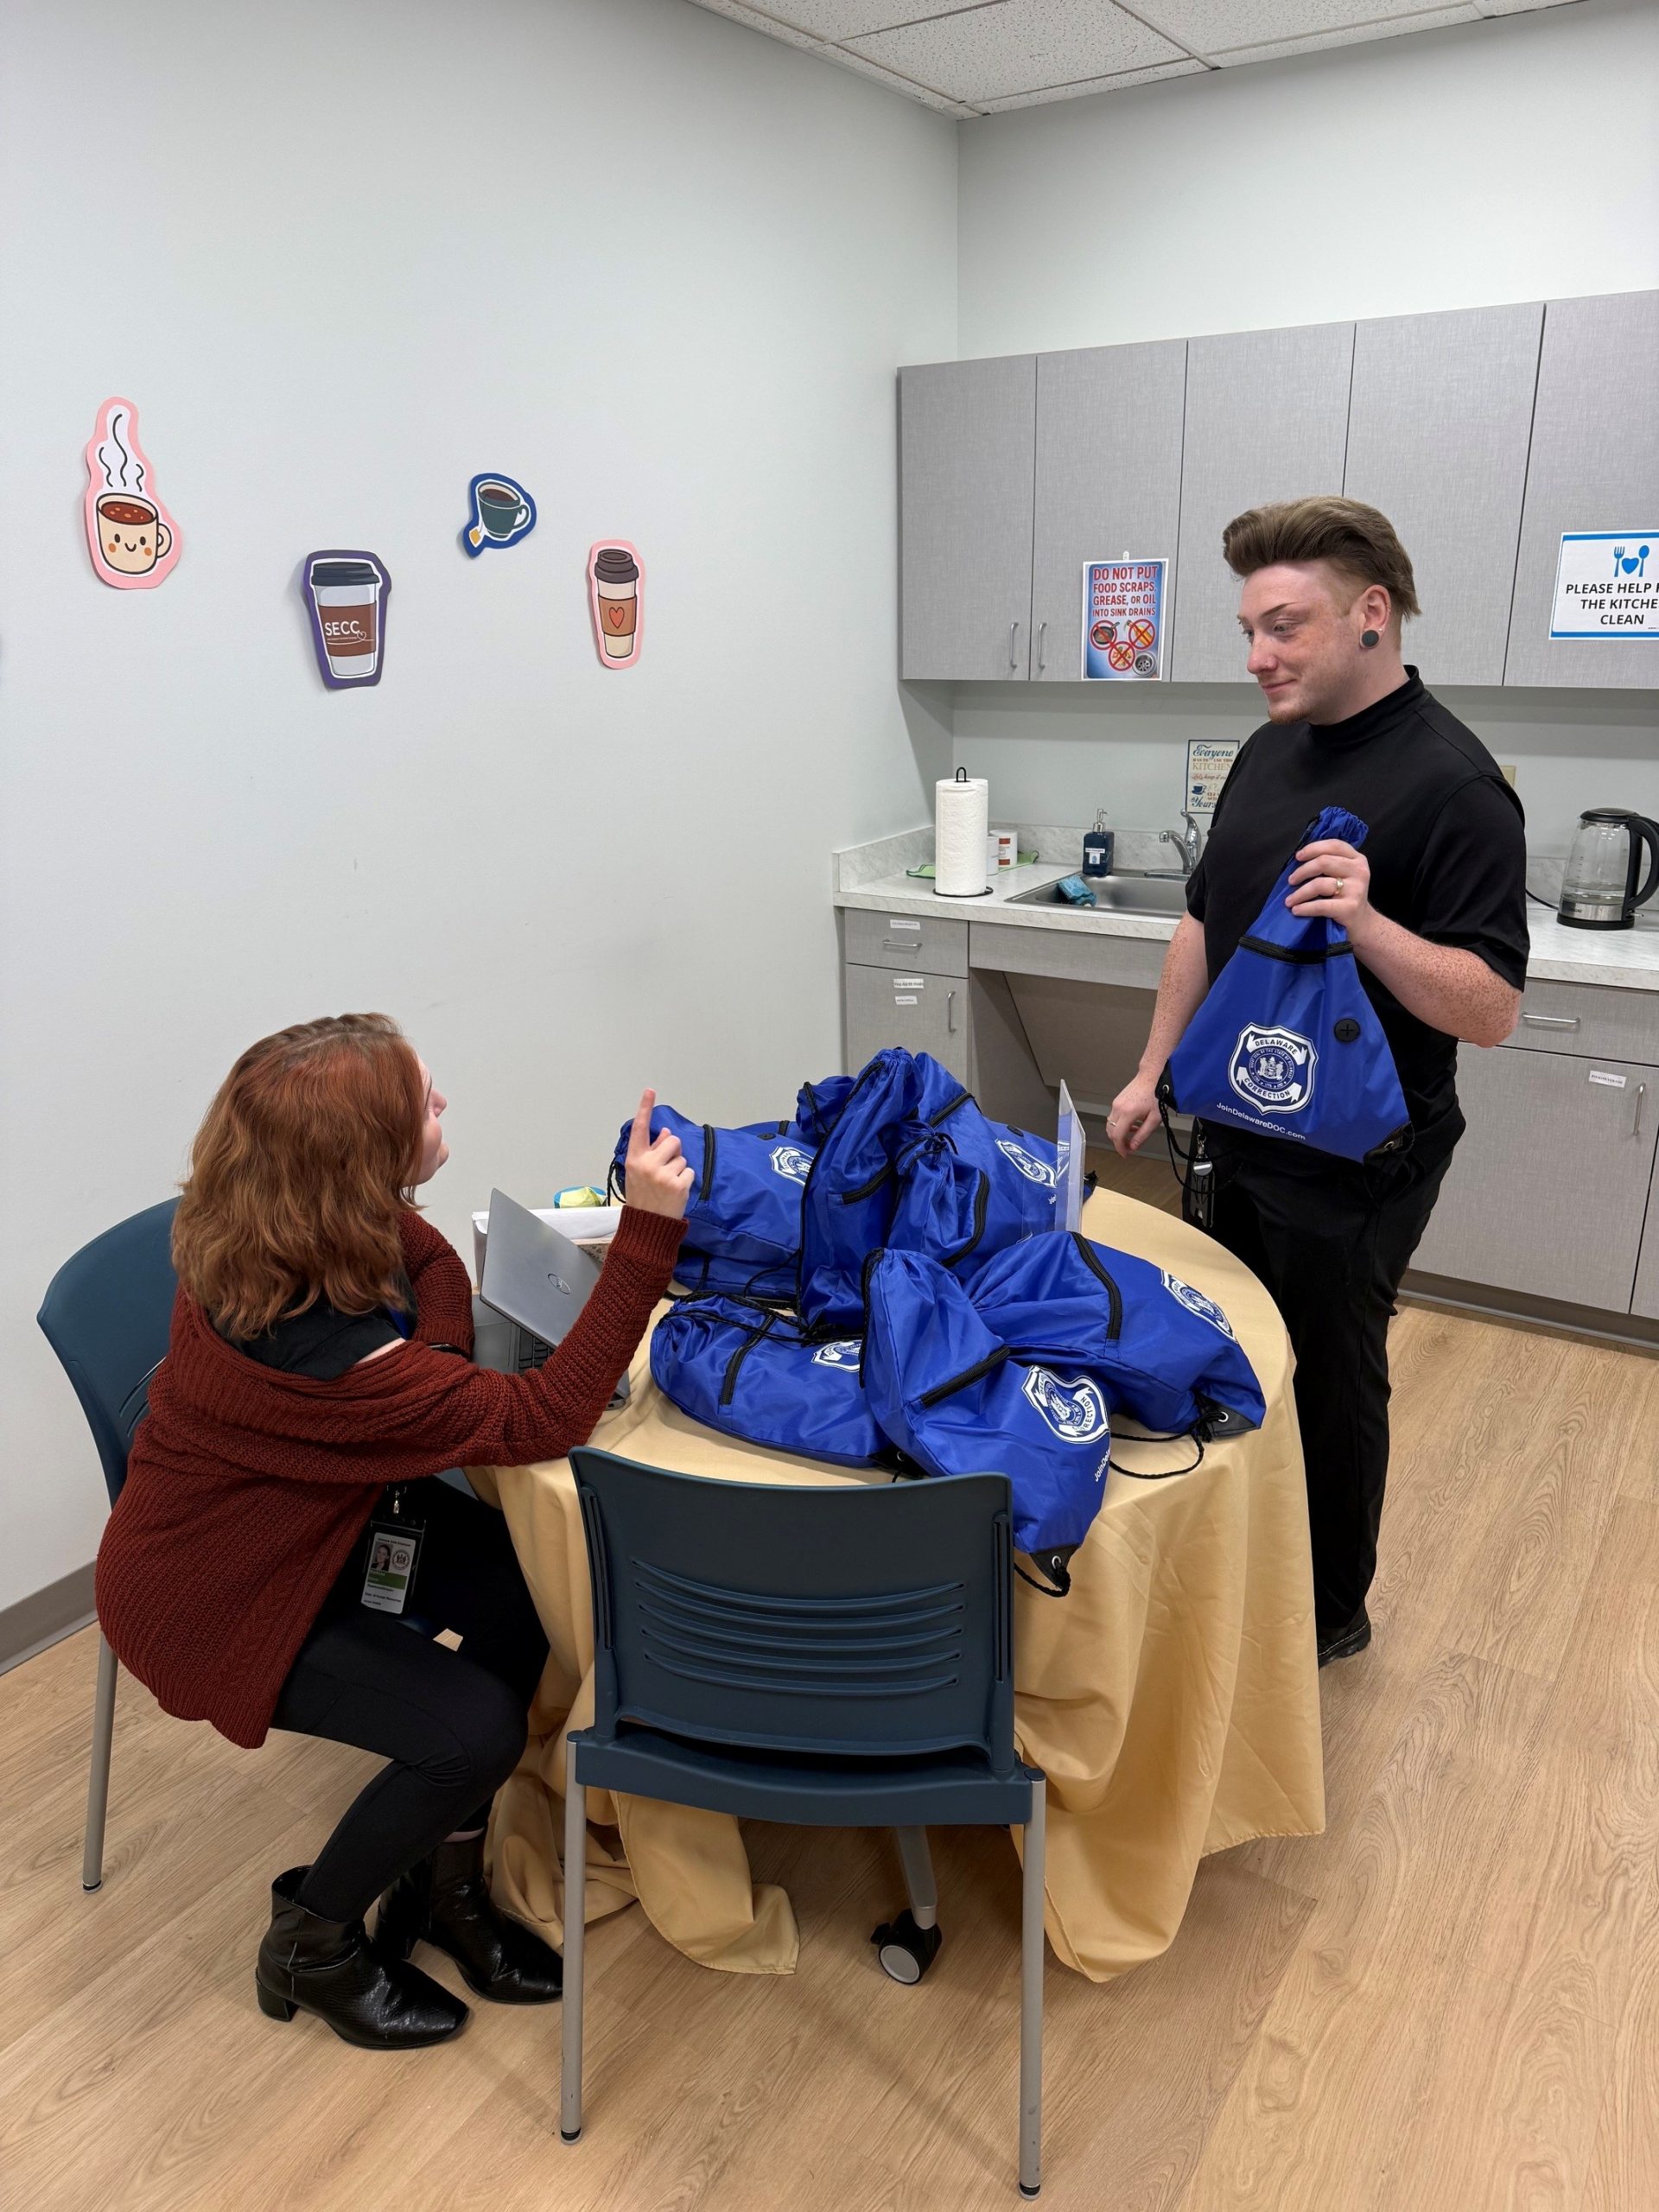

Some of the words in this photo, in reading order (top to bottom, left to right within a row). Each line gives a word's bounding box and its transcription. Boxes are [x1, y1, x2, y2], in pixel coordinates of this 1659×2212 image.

[1093, 569, 1109, 581] DO
[1112, 567, 1134, 580] NOT
[1136, 566, 1158, 579] PUT
[1093, 582, 1117, 594] FOOD
[1566, 583, 1613, 594] PLEASE
[1618, 582, 1651, 594] HELP
[1093, 594, 1128, 606] GREASE,
[1130, 595, 1141, 604] OR
[1142, 594, 1156, 604] OIL
[1580, 599, 1606, 609] THE
[1610, 599, 1659, 609] KITCHE
[1092, 607, 1109, 617] INTO
[1110, 607, 1127, 617] SINK
[1128, 607, 1156, 616] DRAINS
[1600, 614, 1644, 625] CLEAN
[324, 620, 360, 636] SECC
[1255, 1039, 1298, 1055] DELAWARE
[1243, 1077, 1291, 1099] CORRECTION
[1217, 1102, 1306, 1141] JoinDelawareDOC.com
